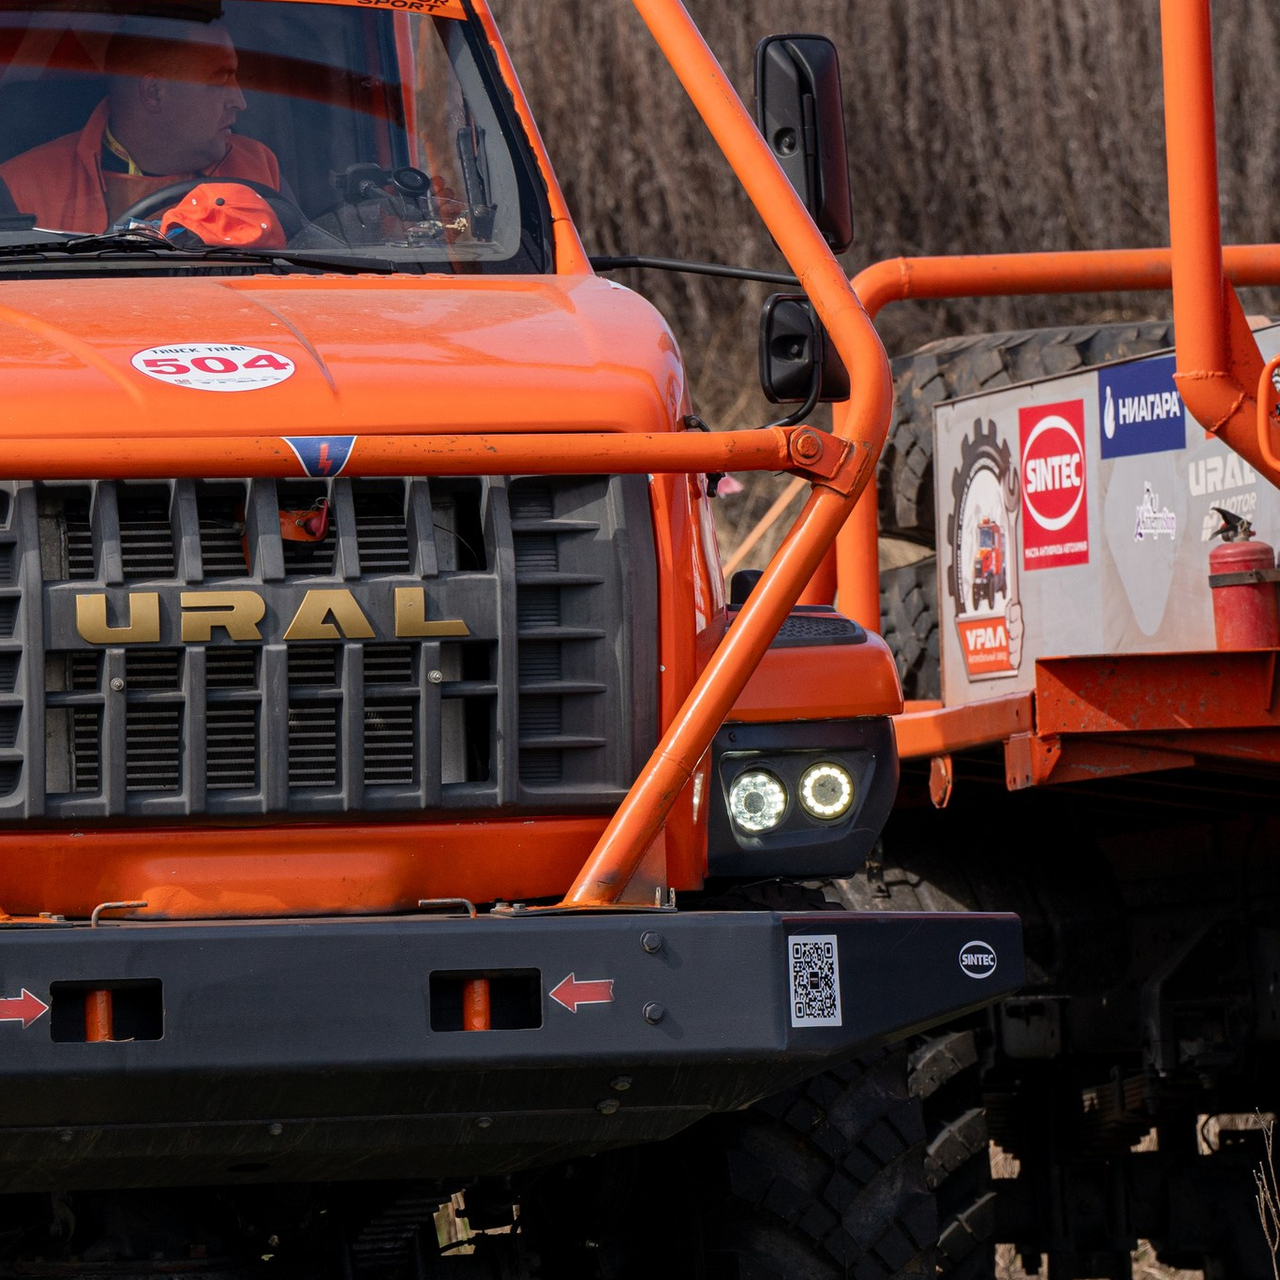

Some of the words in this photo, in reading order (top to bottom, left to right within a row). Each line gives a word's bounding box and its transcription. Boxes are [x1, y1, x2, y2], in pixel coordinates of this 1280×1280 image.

[143, 354, 291, 375] 504
[150, 347, 200, 356] TRUCK
[207, 345, 252, 353] TRIAL
[1119, 391, 1180, 425] НИАГАРА
[1026, 452, 1081, 494] SINTEC
[1189, 452, 1257, 497] URAL
[76, 586, 471, 645] URAL
[965, 625, 1007, 651] УРАЛ
[962, 953, 995, 966] SINTEC
